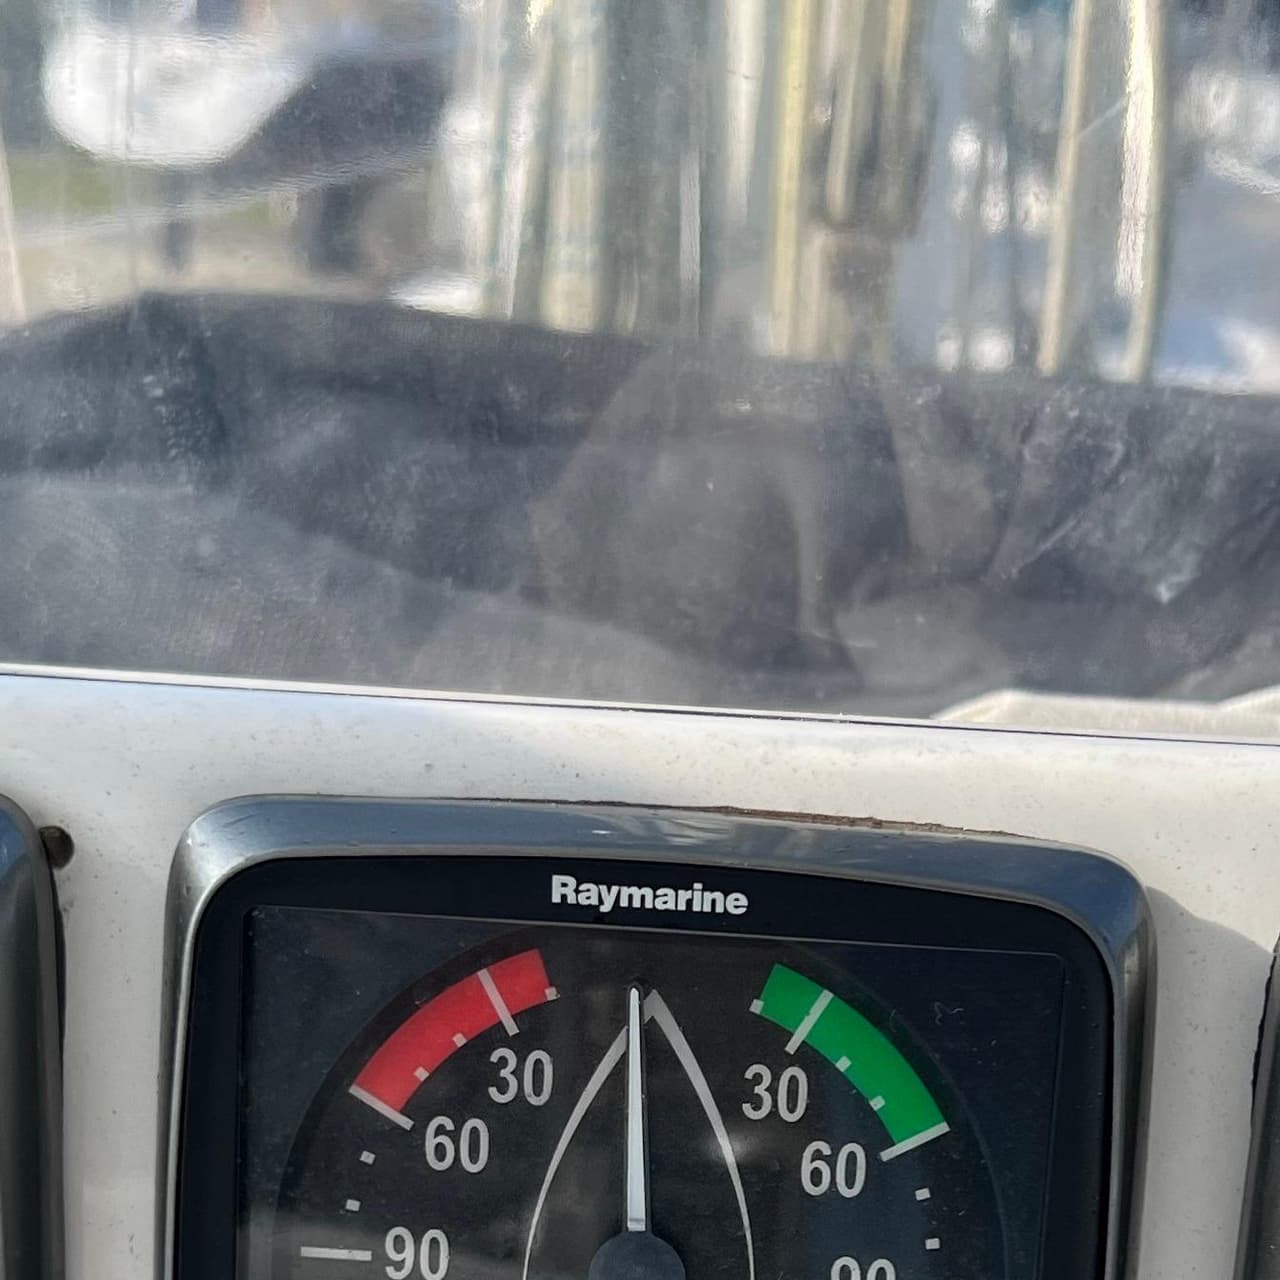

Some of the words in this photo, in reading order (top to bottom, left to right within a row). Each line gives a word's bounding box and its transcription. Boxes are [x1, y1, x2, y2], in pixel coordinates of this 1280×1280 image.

[551, 874, 749, 915] Raymarine
[487, 1047, 554, 1106] 30
[741, 1063, 808, 1123] 30
[424, 1115, 490, 1173] 60
[800, 1140, 866, 1198] 60
